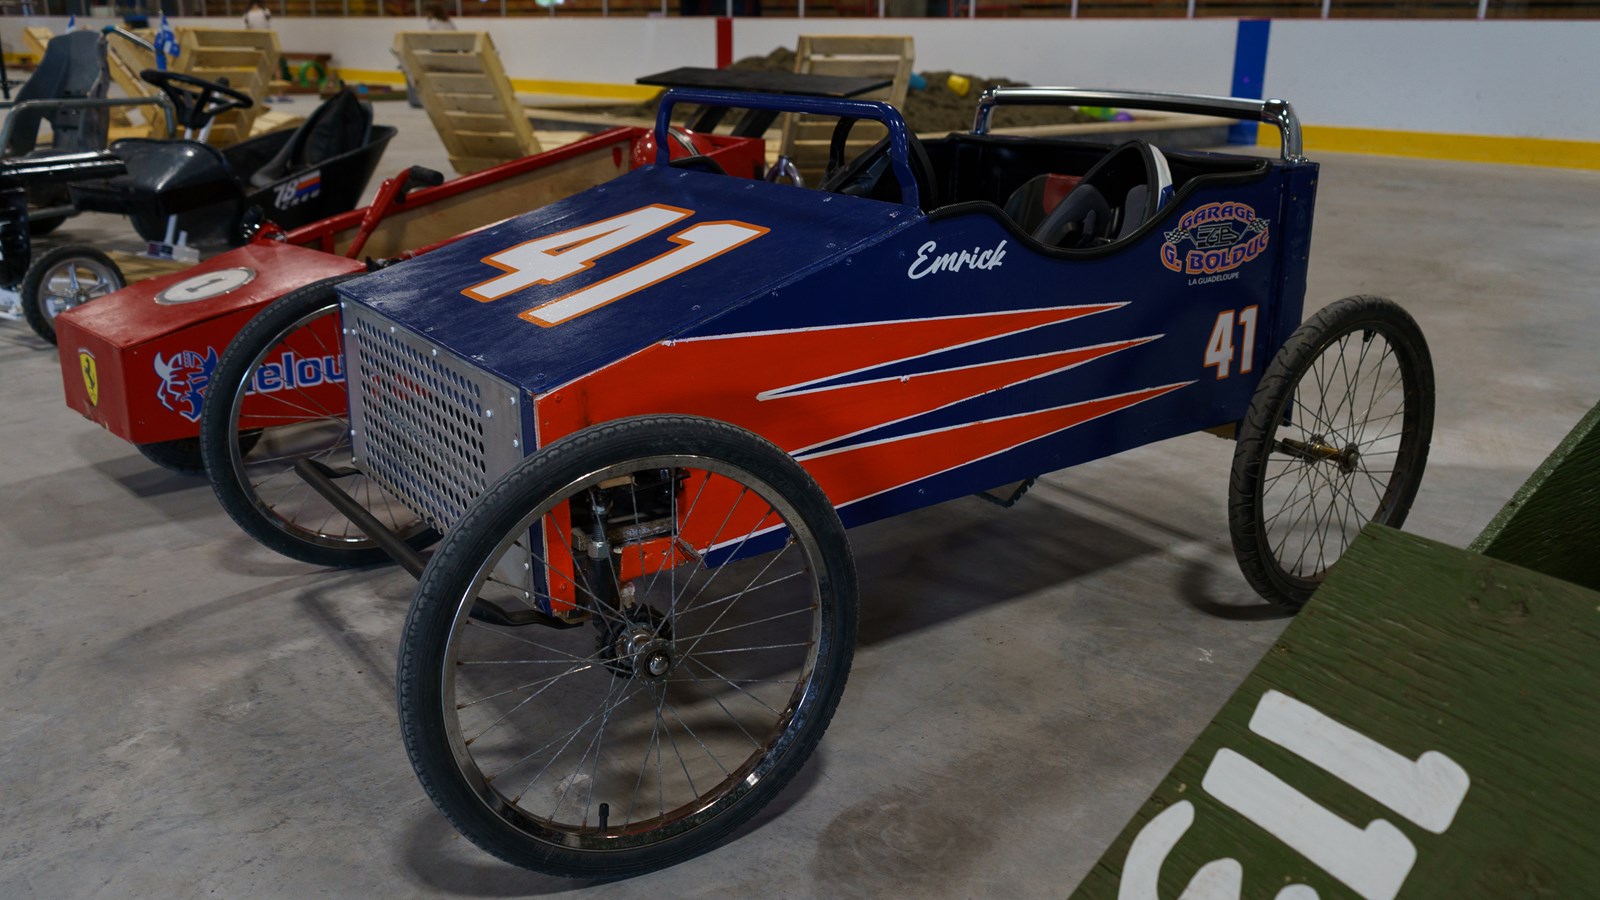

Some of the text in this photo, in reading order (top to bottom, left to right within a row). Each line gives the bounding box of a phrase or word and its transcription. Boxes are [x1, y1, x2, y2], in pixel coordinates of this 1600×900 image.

[1179, 202, 1256, 230] GARAGE
[460, 203, 771, 328] 41
[908, 240, 1007, 280] Emrick
[1161, 229, 1270, 275] G. BOLDUC
[184, 277, 225, 293] 1
[1188, 272, 1240, 286] LA GUADELOUPE
[1203, 304, 1259, 380] 41
